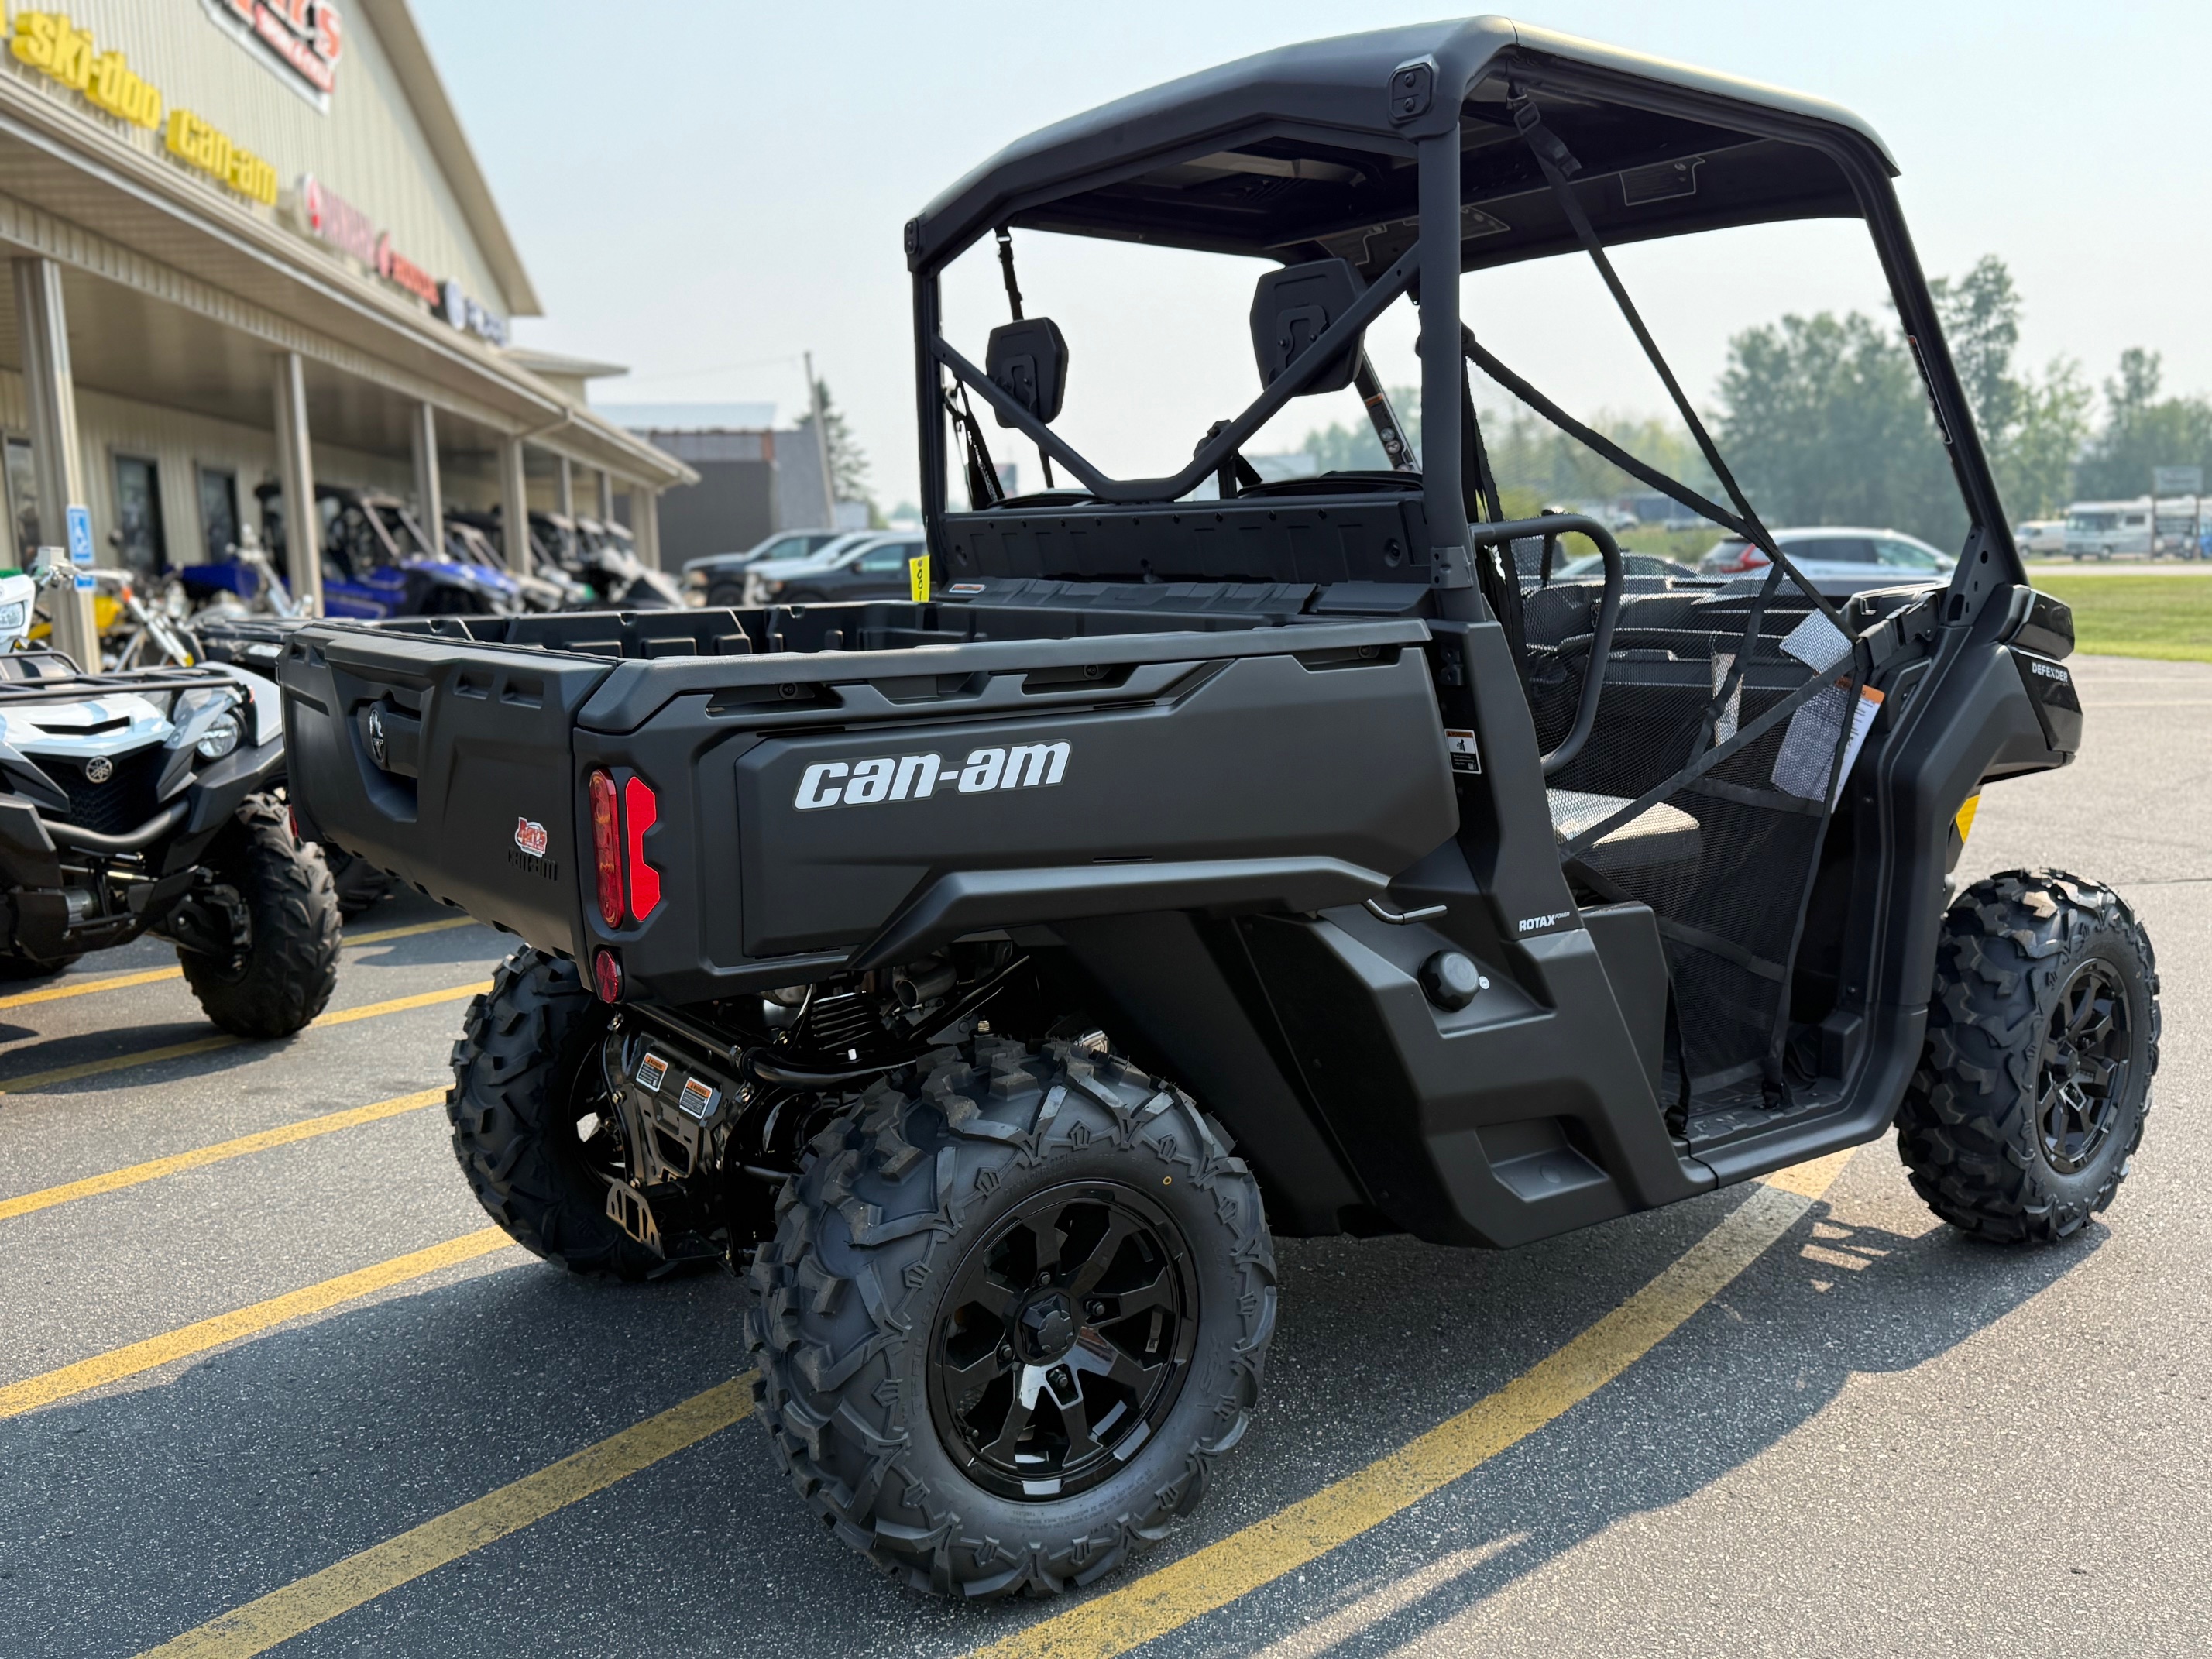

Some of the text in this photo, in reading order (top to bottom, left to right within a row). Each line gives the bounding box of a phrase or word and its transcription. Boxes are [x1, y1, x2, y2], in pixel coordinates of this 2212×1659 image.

[2032, 662, 2067, 682] DEFENDER
[793, 741, 1071, 811] can-am
[1518, 915, 1555, 933] ROTAX
